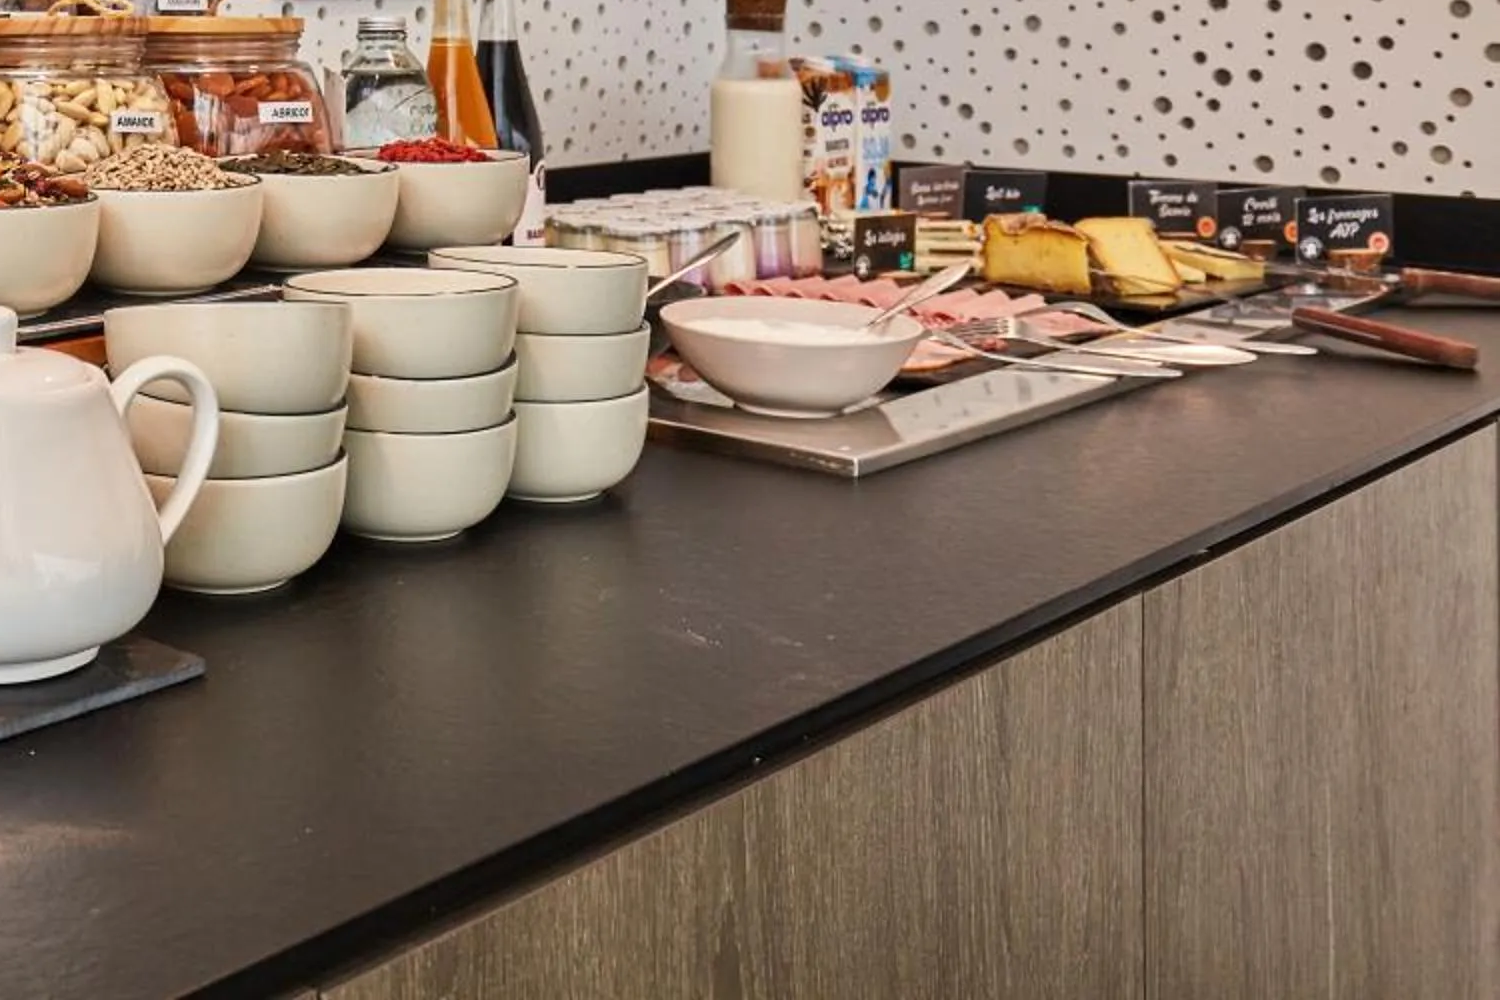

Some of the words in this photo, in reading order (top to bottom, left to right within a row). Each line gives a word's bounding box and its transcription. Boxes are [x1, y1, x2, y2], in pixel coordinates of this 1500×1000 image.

[272, 107, 309, 118] ABRICOT
[822, 105, 853, 131] alpro
[861, 102, 889, 129] alpro
[1326, 208, 1378, 225] fromages
